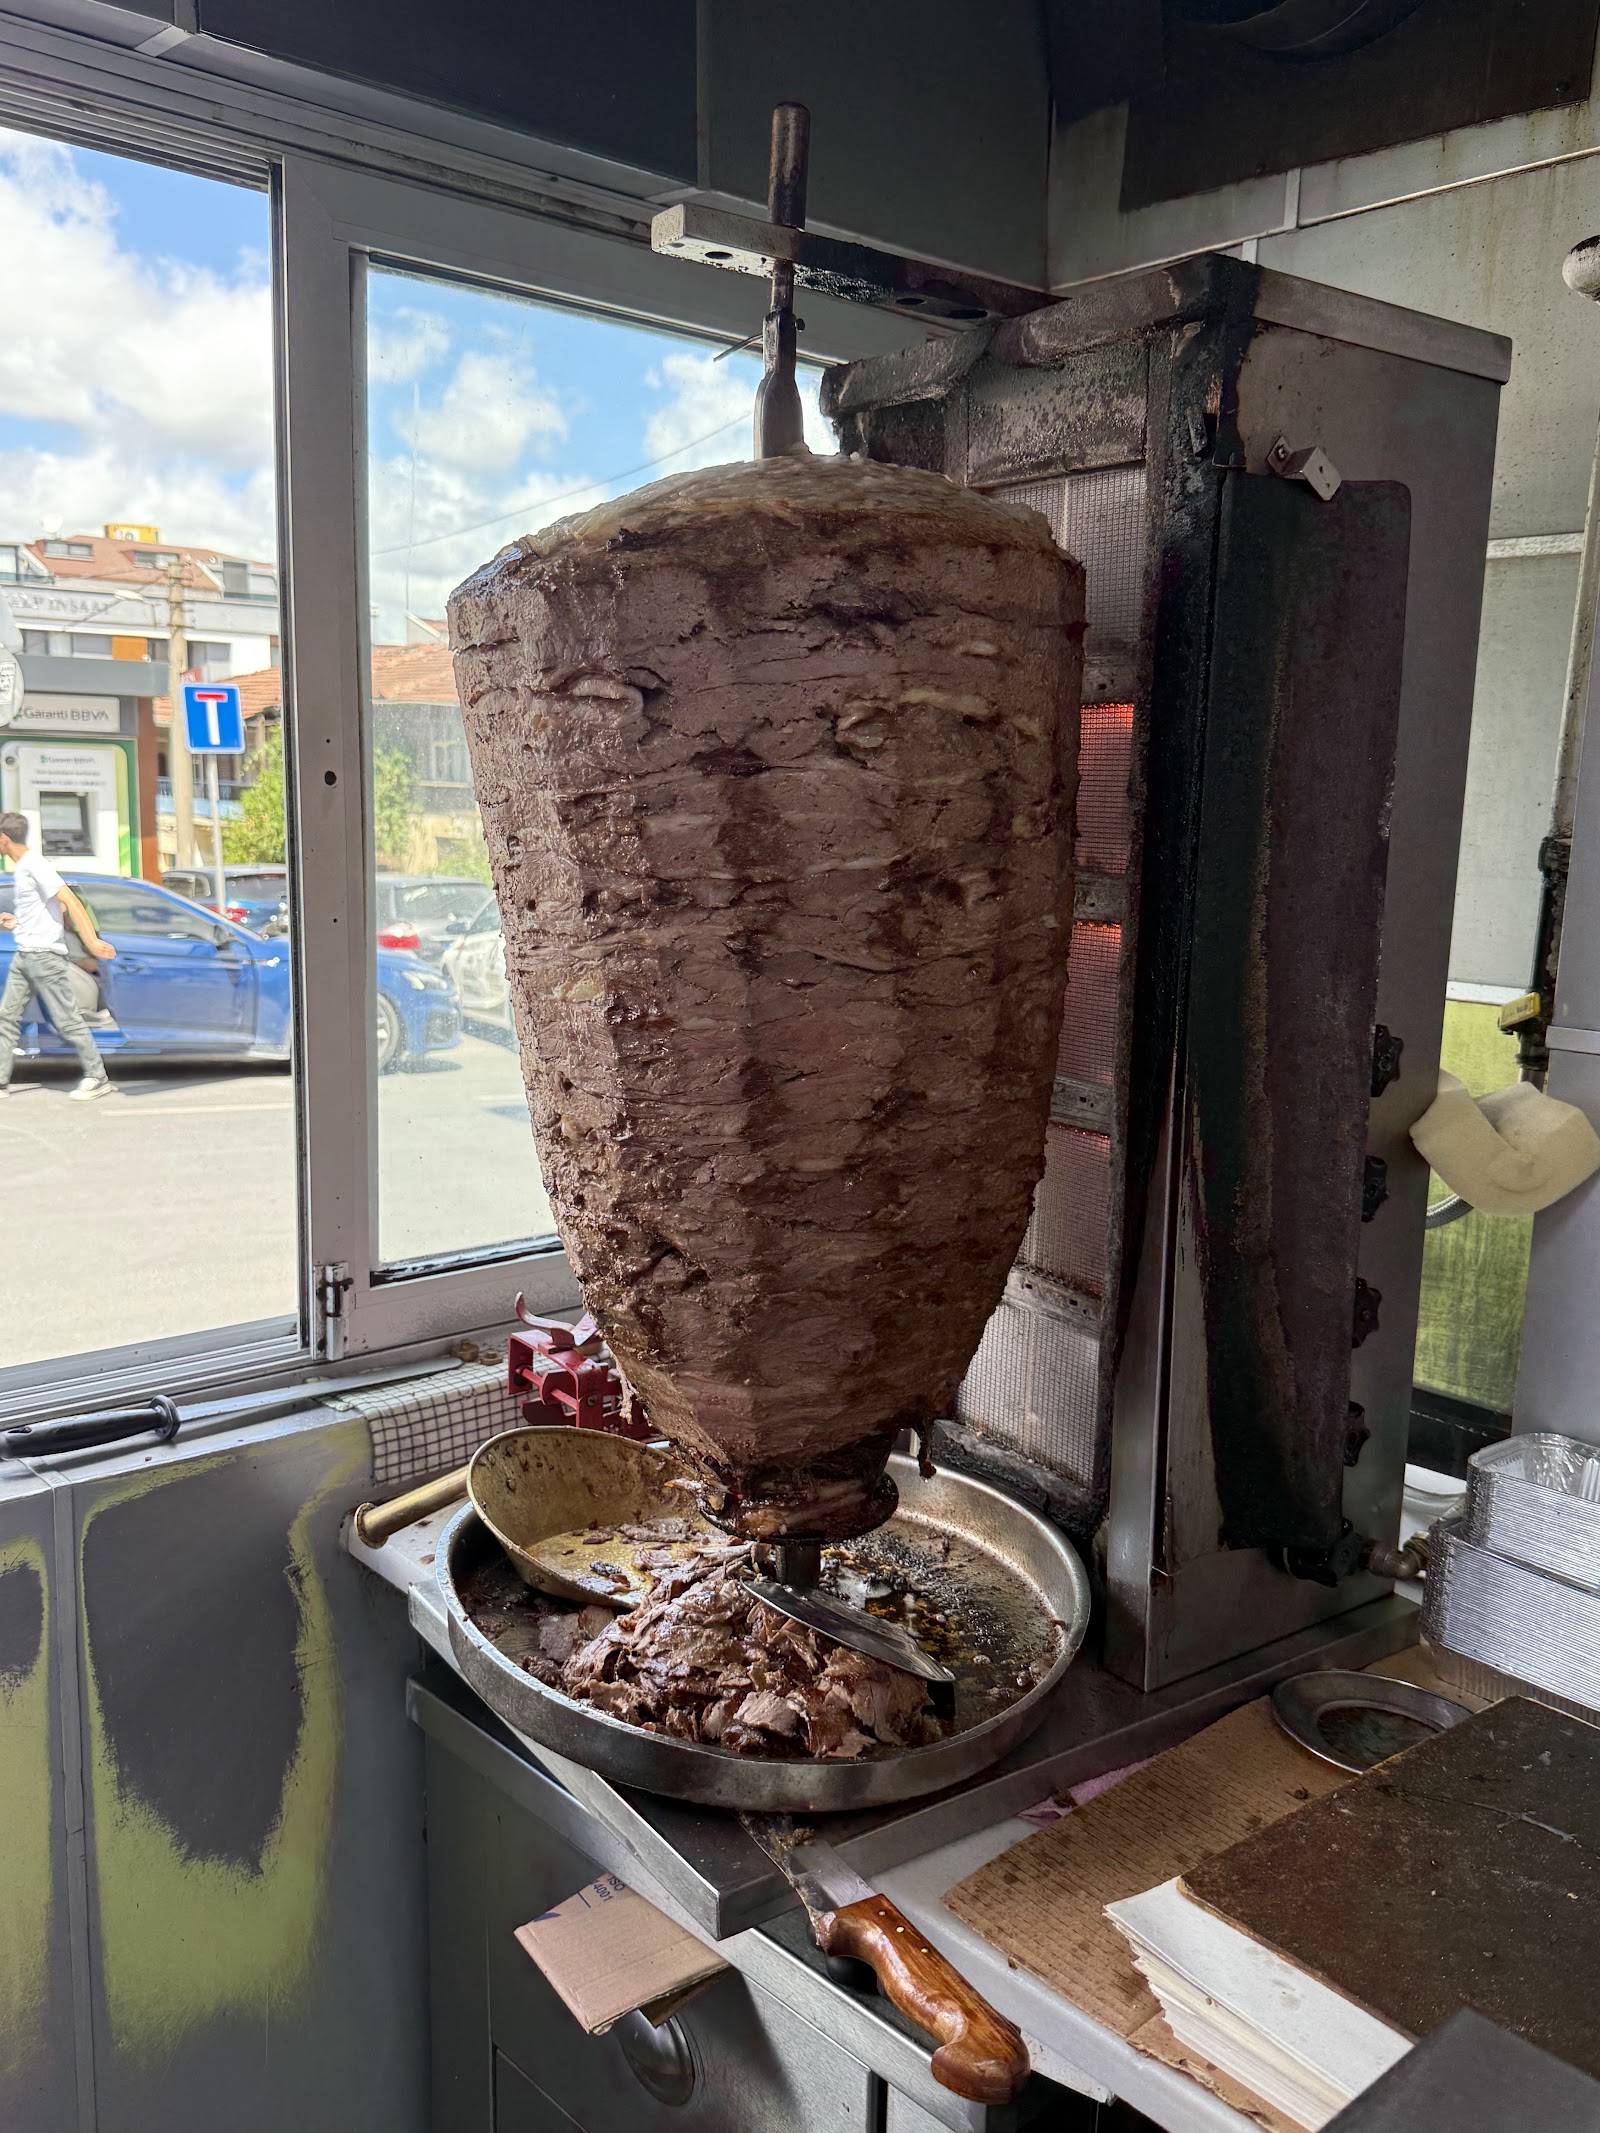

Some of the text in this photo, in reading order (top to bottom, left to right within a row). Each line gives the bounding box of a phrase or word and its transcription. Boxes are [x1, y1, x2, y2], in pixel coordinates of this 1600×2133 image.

[24, 705, 109, 721] Garanti BBVA
[608, 1876, 625, 1891] ISO
